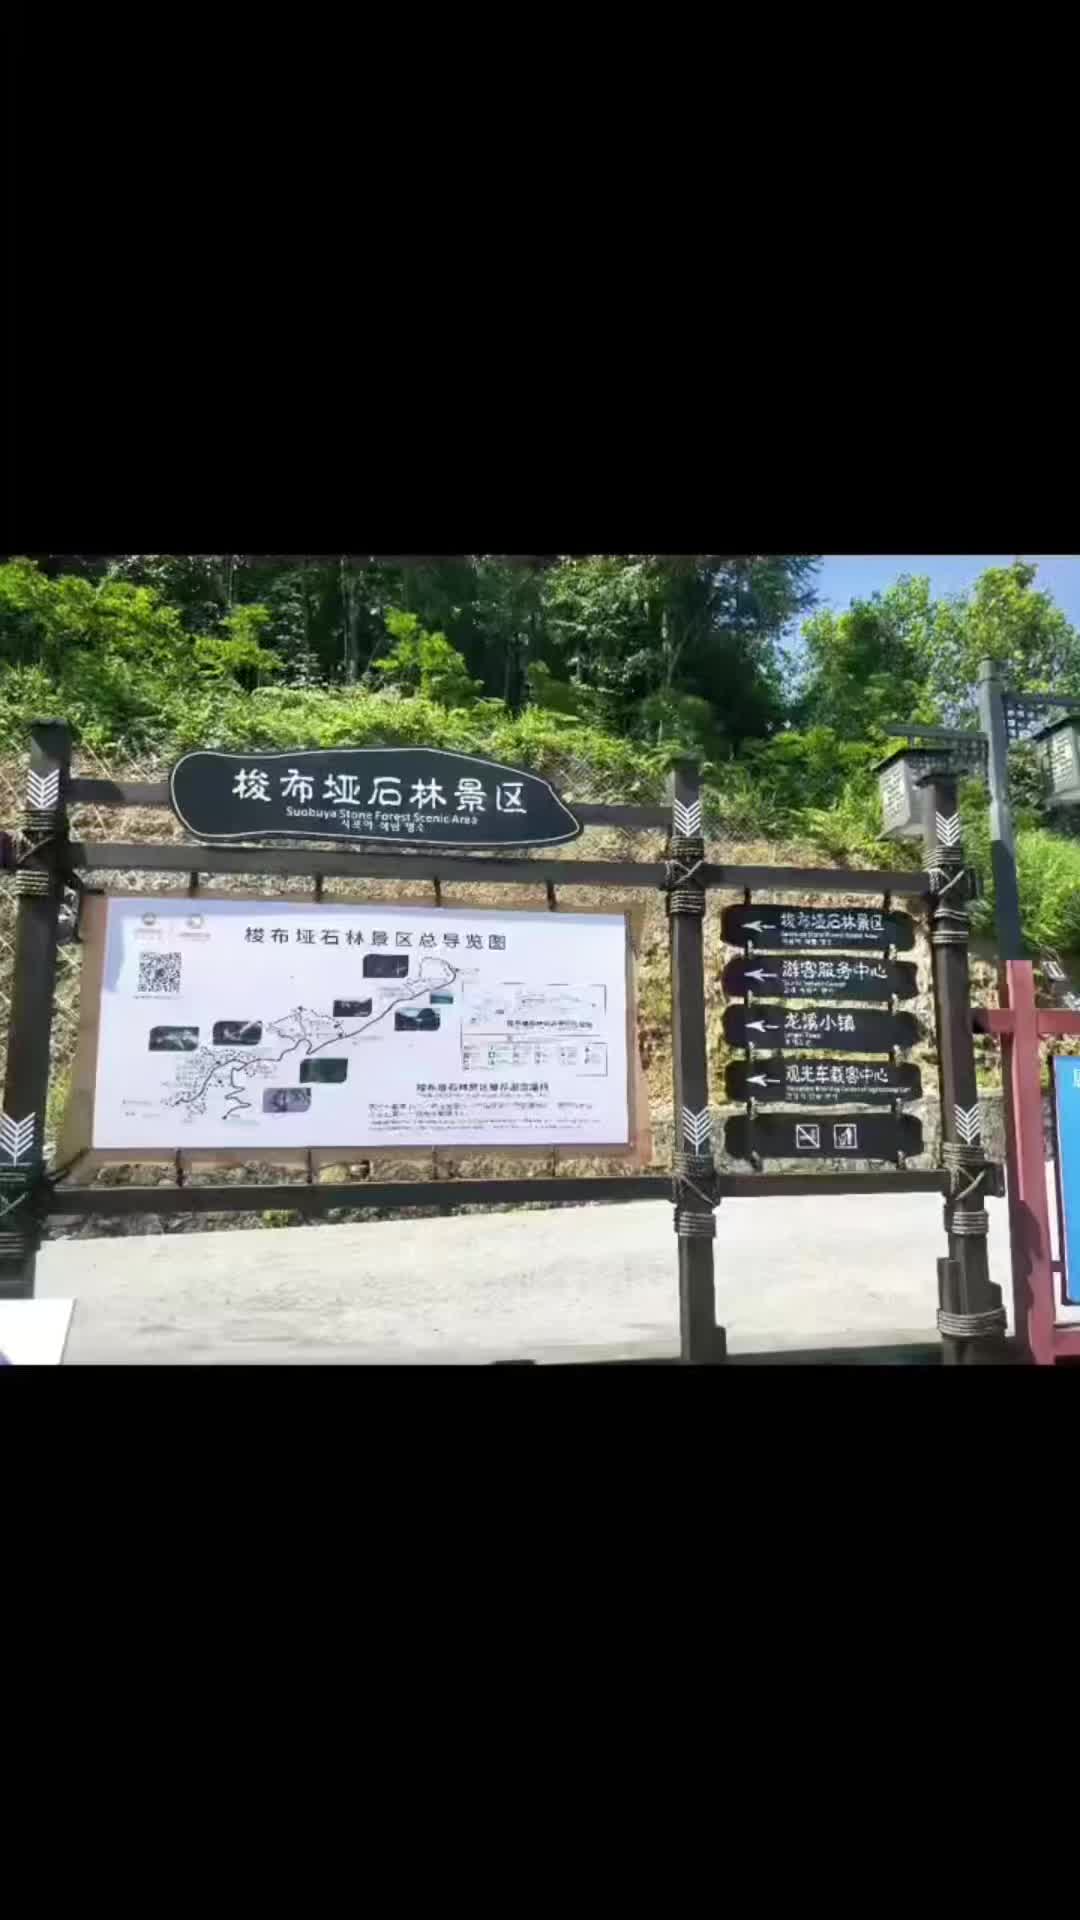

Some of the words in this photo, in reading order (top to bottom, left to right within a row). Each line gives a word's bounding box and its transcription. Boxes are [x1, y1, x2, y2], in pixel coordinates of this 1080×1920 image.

[231, 768, 528, 814] 梭布垭石林景区
[285, 806, 337, 820] Suobuya
[339, 808, 373, 821] Stone
[375, 809, 411, 823] Forest
[413, 812, 450, 825] Scenic
[451, 814, 478, 826] Area
[780, 911, 886, 932] 梭布垭石林景区
[244, 926, 507, 951] 梭布垭石林景区总导览图
[782, 959, 889, 981] 游客服务中心
[783, 1011, 857, 1033] 龙溪小镇
[785, 1064, 889, 1085] 观光车载客中心
